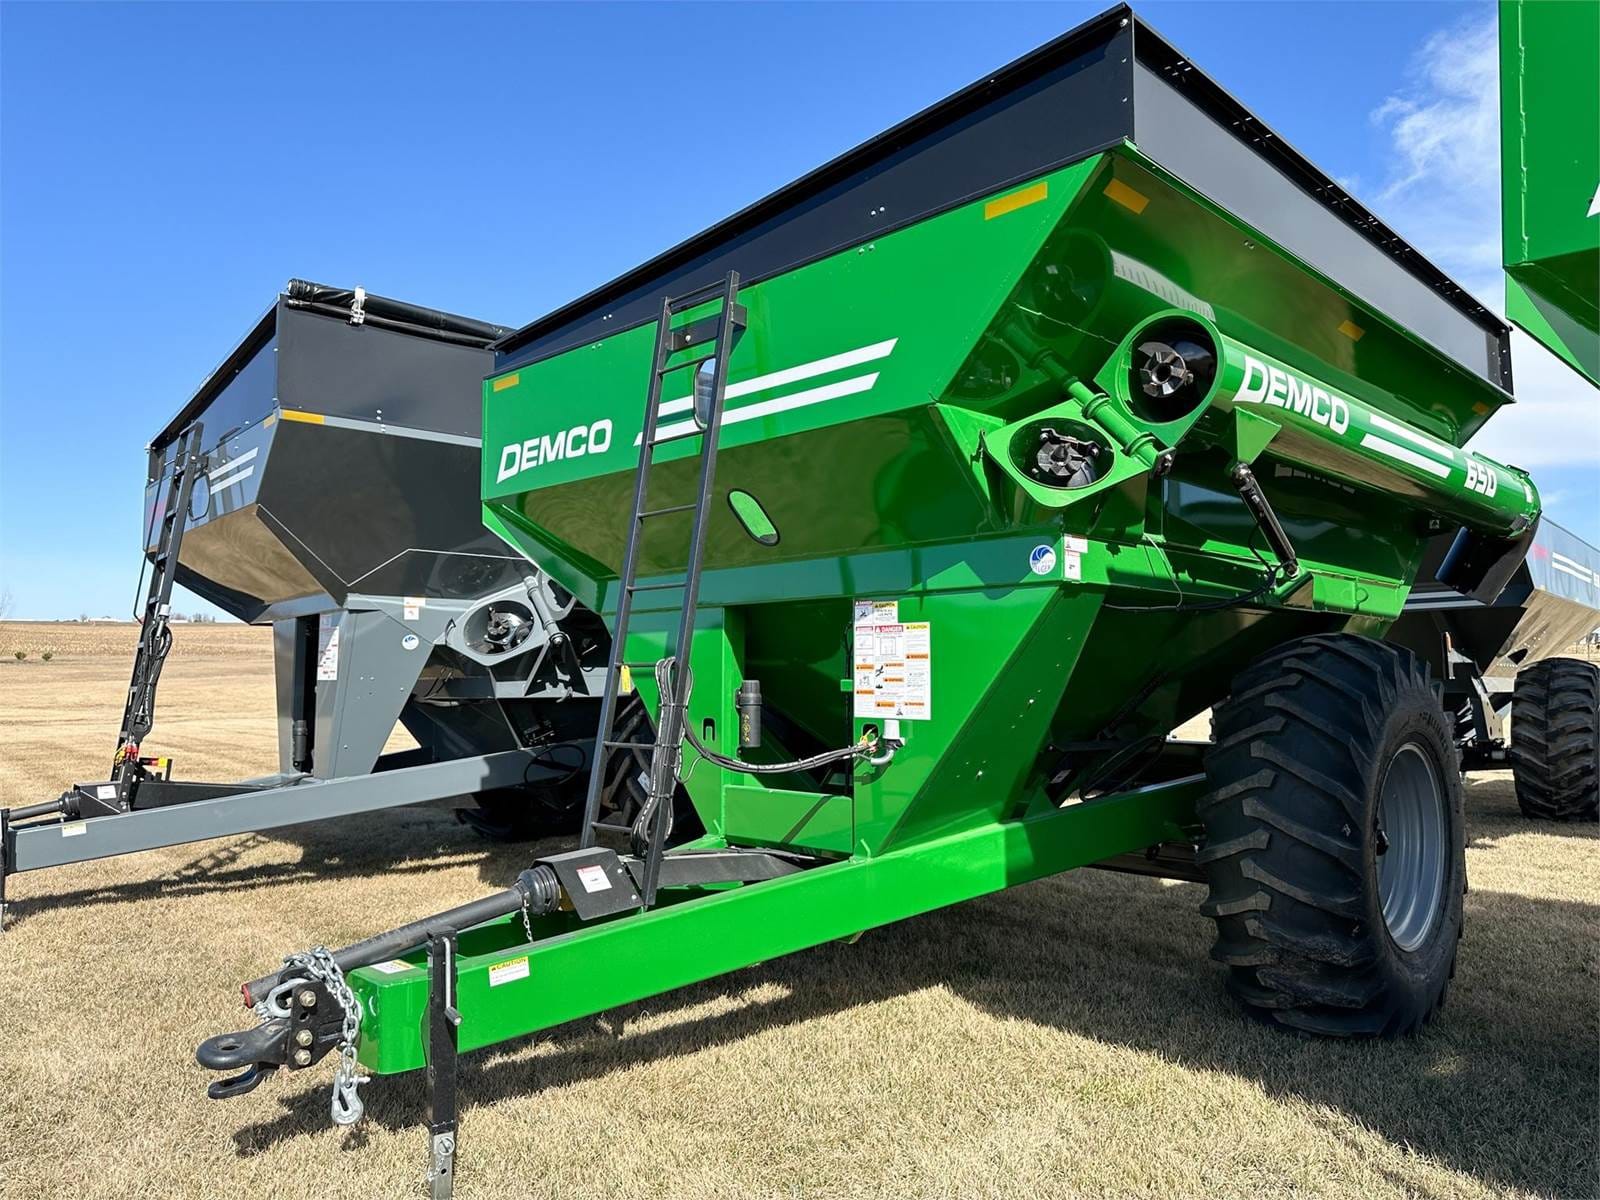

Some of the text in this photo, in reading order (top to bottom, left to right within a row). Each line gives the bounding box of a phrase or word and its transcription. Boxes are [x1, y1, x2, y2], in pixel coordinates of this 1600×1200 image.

[1232, 355, 1350, 435] DEMCO
[496, 418, 613, 484] DEMCO
[1464, 457, 1497, 498] 650
